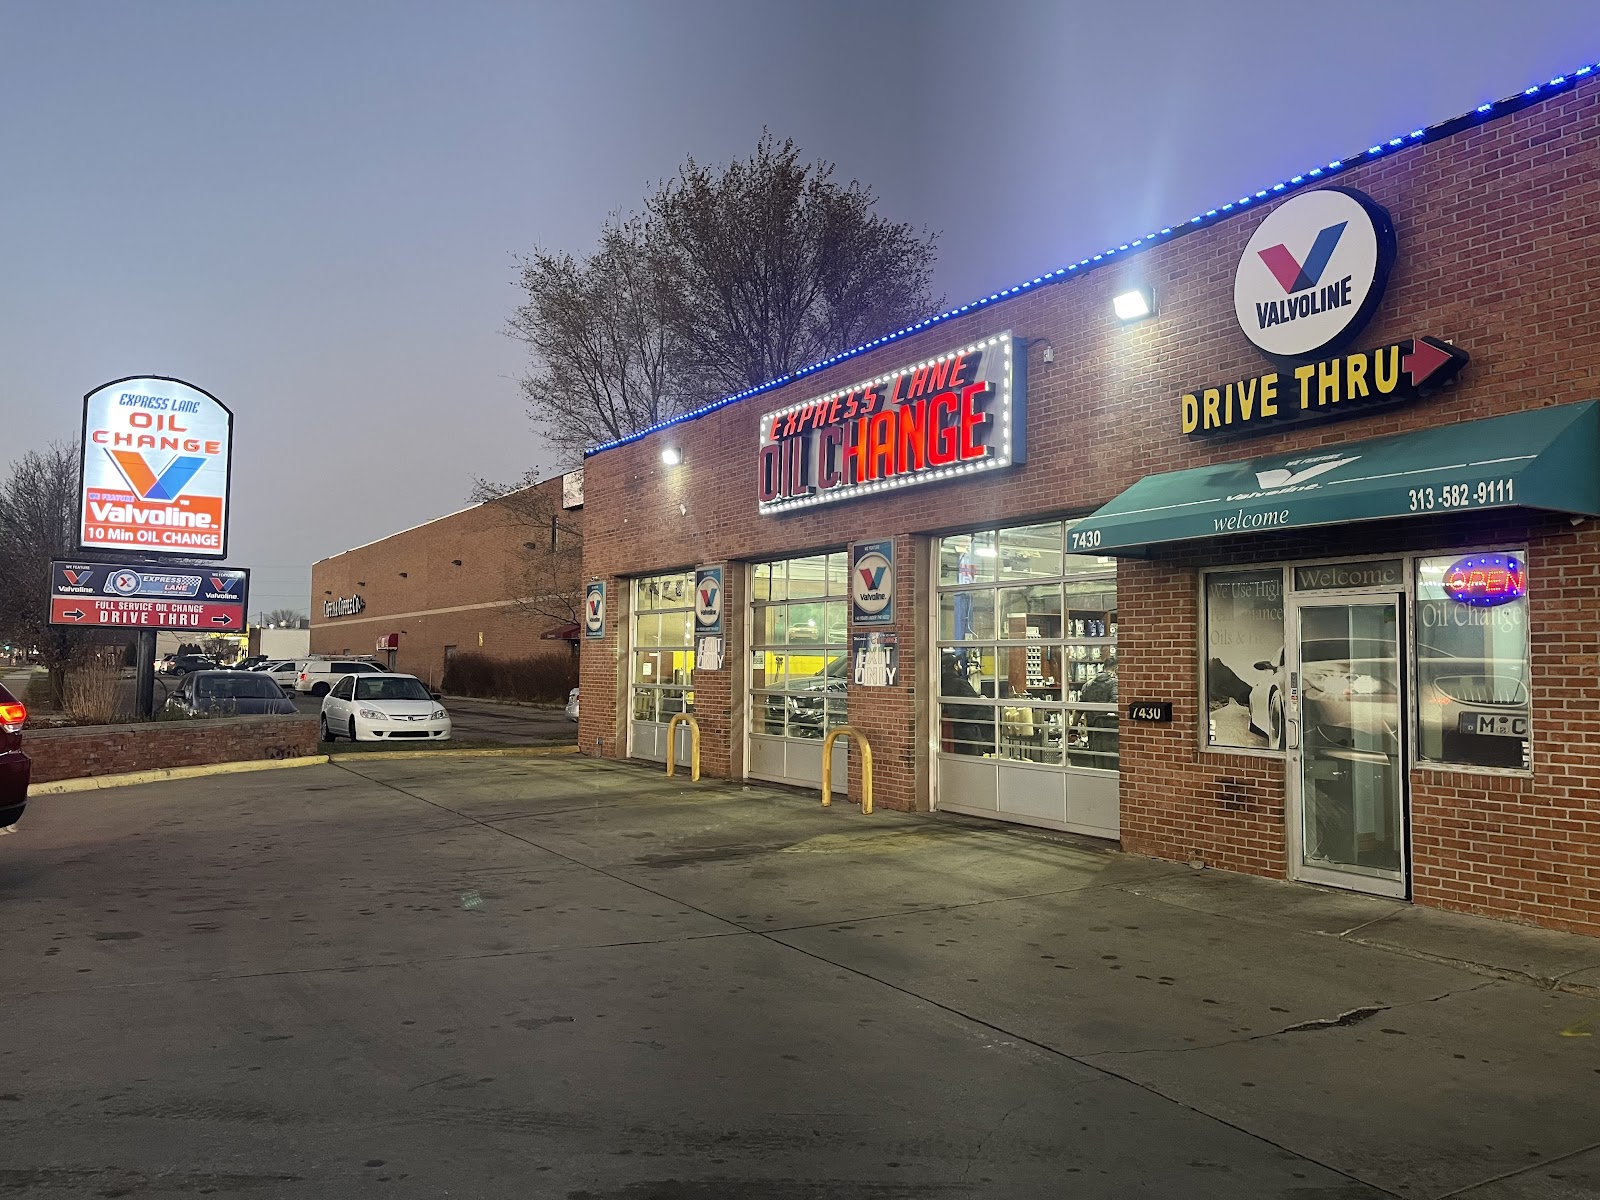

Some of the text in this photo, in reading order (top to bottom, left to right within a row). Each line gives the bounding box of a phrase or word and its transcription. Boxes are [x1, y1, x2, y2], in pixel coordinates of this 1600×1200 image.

[1256, 275, 1352, 330] VALVOLINE
[770, 350, 975, 441] EXPRESS LANE
[1181, 345, 1399, 434] DRIVE THRU
[119, 393, 200, 414] EXPRESS LANE
[129, 411, 188, 433] OIL
[92, 430, 222, 455] CHANGE
[759, 381, 989, 502] OIL CHANGE
[1213, 509, 1289, 532] welcome
[88, 527, 219, 546] 10 Min OIL CHANGE
[1072, 530, 1101, 549] 7430
[143, 575, 182, 584] EXPRESS
[1299, 567, 1395, 587] Welcome
[1449, 570, 1524, 592] OPEN
[1210, 580, 1283, 601] We Use High
[95, 601, 204, 613] FULL SERVICE OIL CHANGE
[1422, 601, 1522, 633] Oil Change
[100, 611, 199, 626] DRIVE THRU
[1211, 629, 1233, 645] Oils
[858, 646, 893, 665] EXIT
[854, 668, 897, 686] ONLY
[1132, 707, 1161, 720] 7430
[1480, 716, 1527, 735] M C
